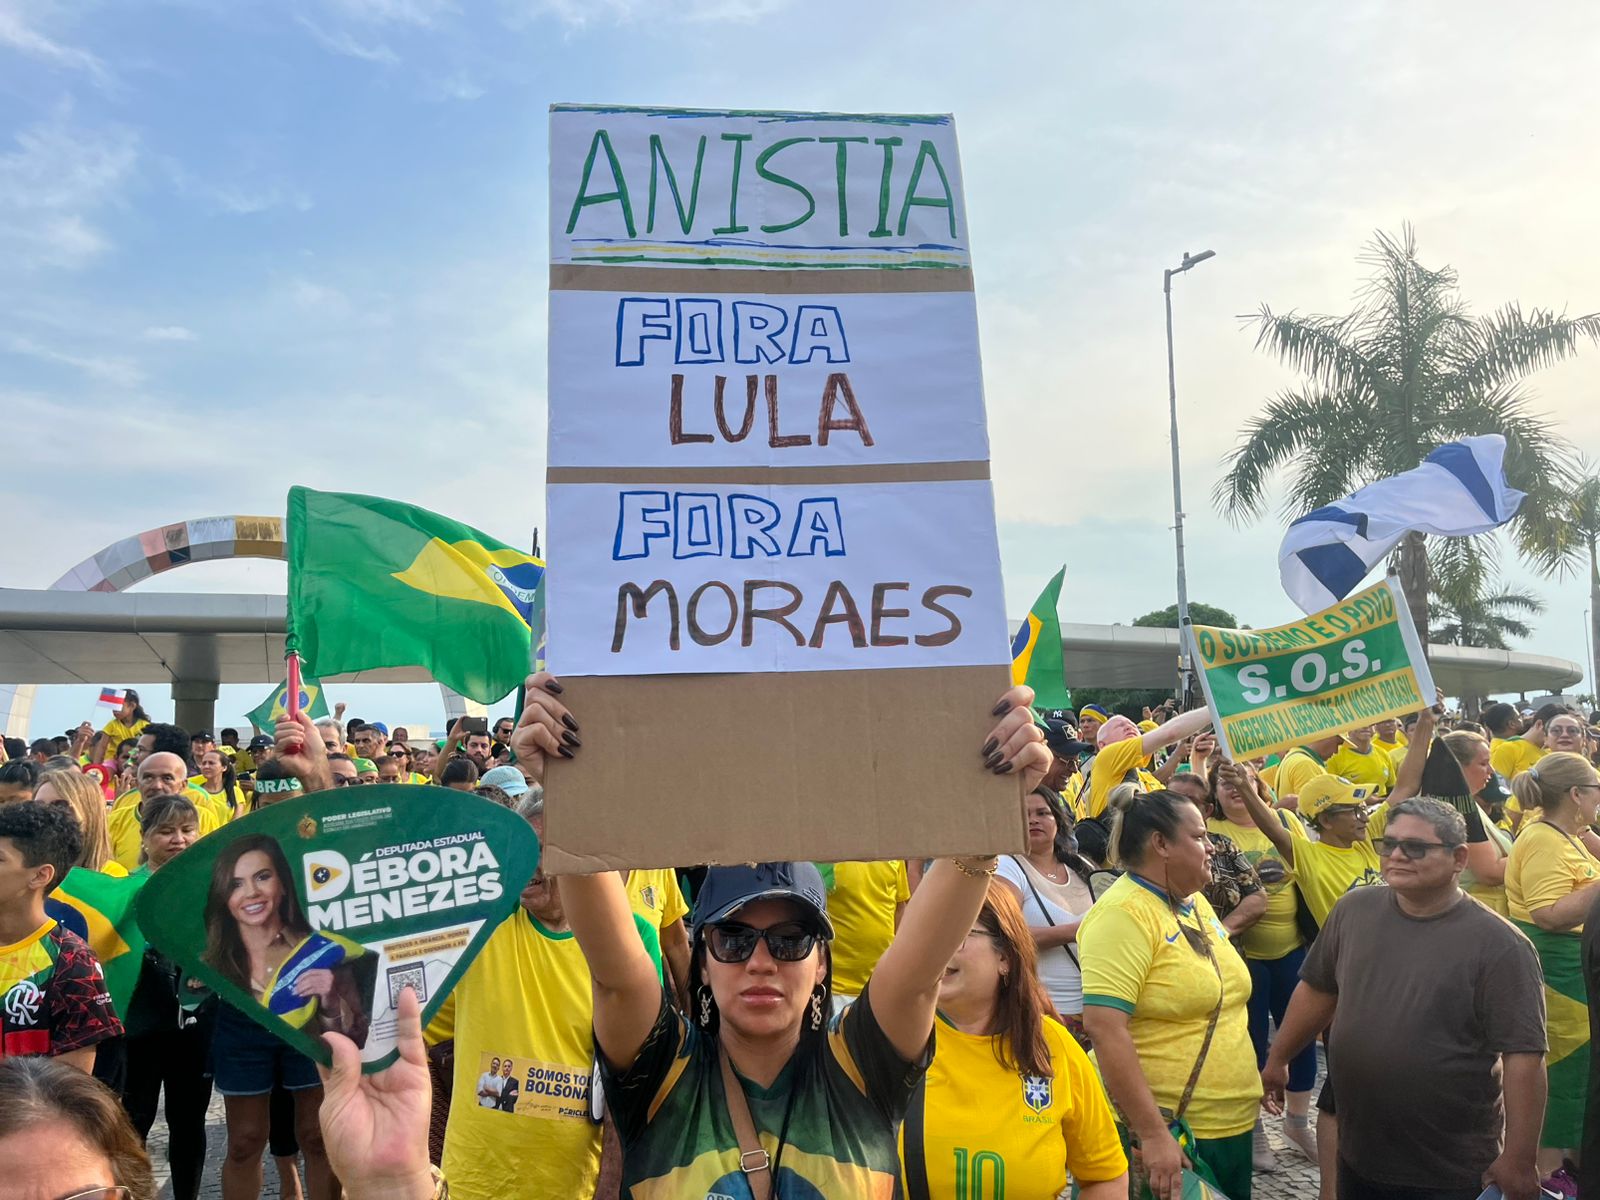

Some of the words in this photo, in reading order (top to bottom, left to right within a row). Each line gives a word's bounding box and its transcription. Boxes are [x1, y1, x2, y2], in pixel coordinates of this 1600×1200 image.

[566, 129, 958, 239] ANISTIA
[616, 297, 850, 367] FORA
[669, 373, 875, 448] LULA
[612, 491, 846, 560] FORA
[611, 579, 972, 652] MORAES
[1199, 630, 1216, 664] O
[1341, 587, 1394, 629] POVO
[1236, 639, 1382, 704] S.O.S.
[1227, 717, 1286, 755] QUEREMOS
[1279, 716, 1293, 738] A
[1348, 684, 1386, 719] NOSSO
[1383, 674, 1420, 714] BRASIL
[303, 841, 500, 903] DÉBORA
[375, 840, 432, 857] DEPUTADA
[433, 831, 485, 848] ESTADUAL
[307, 871, 503, 932] MENEZES
[527, 1067, 571, 1084] SOMOS
